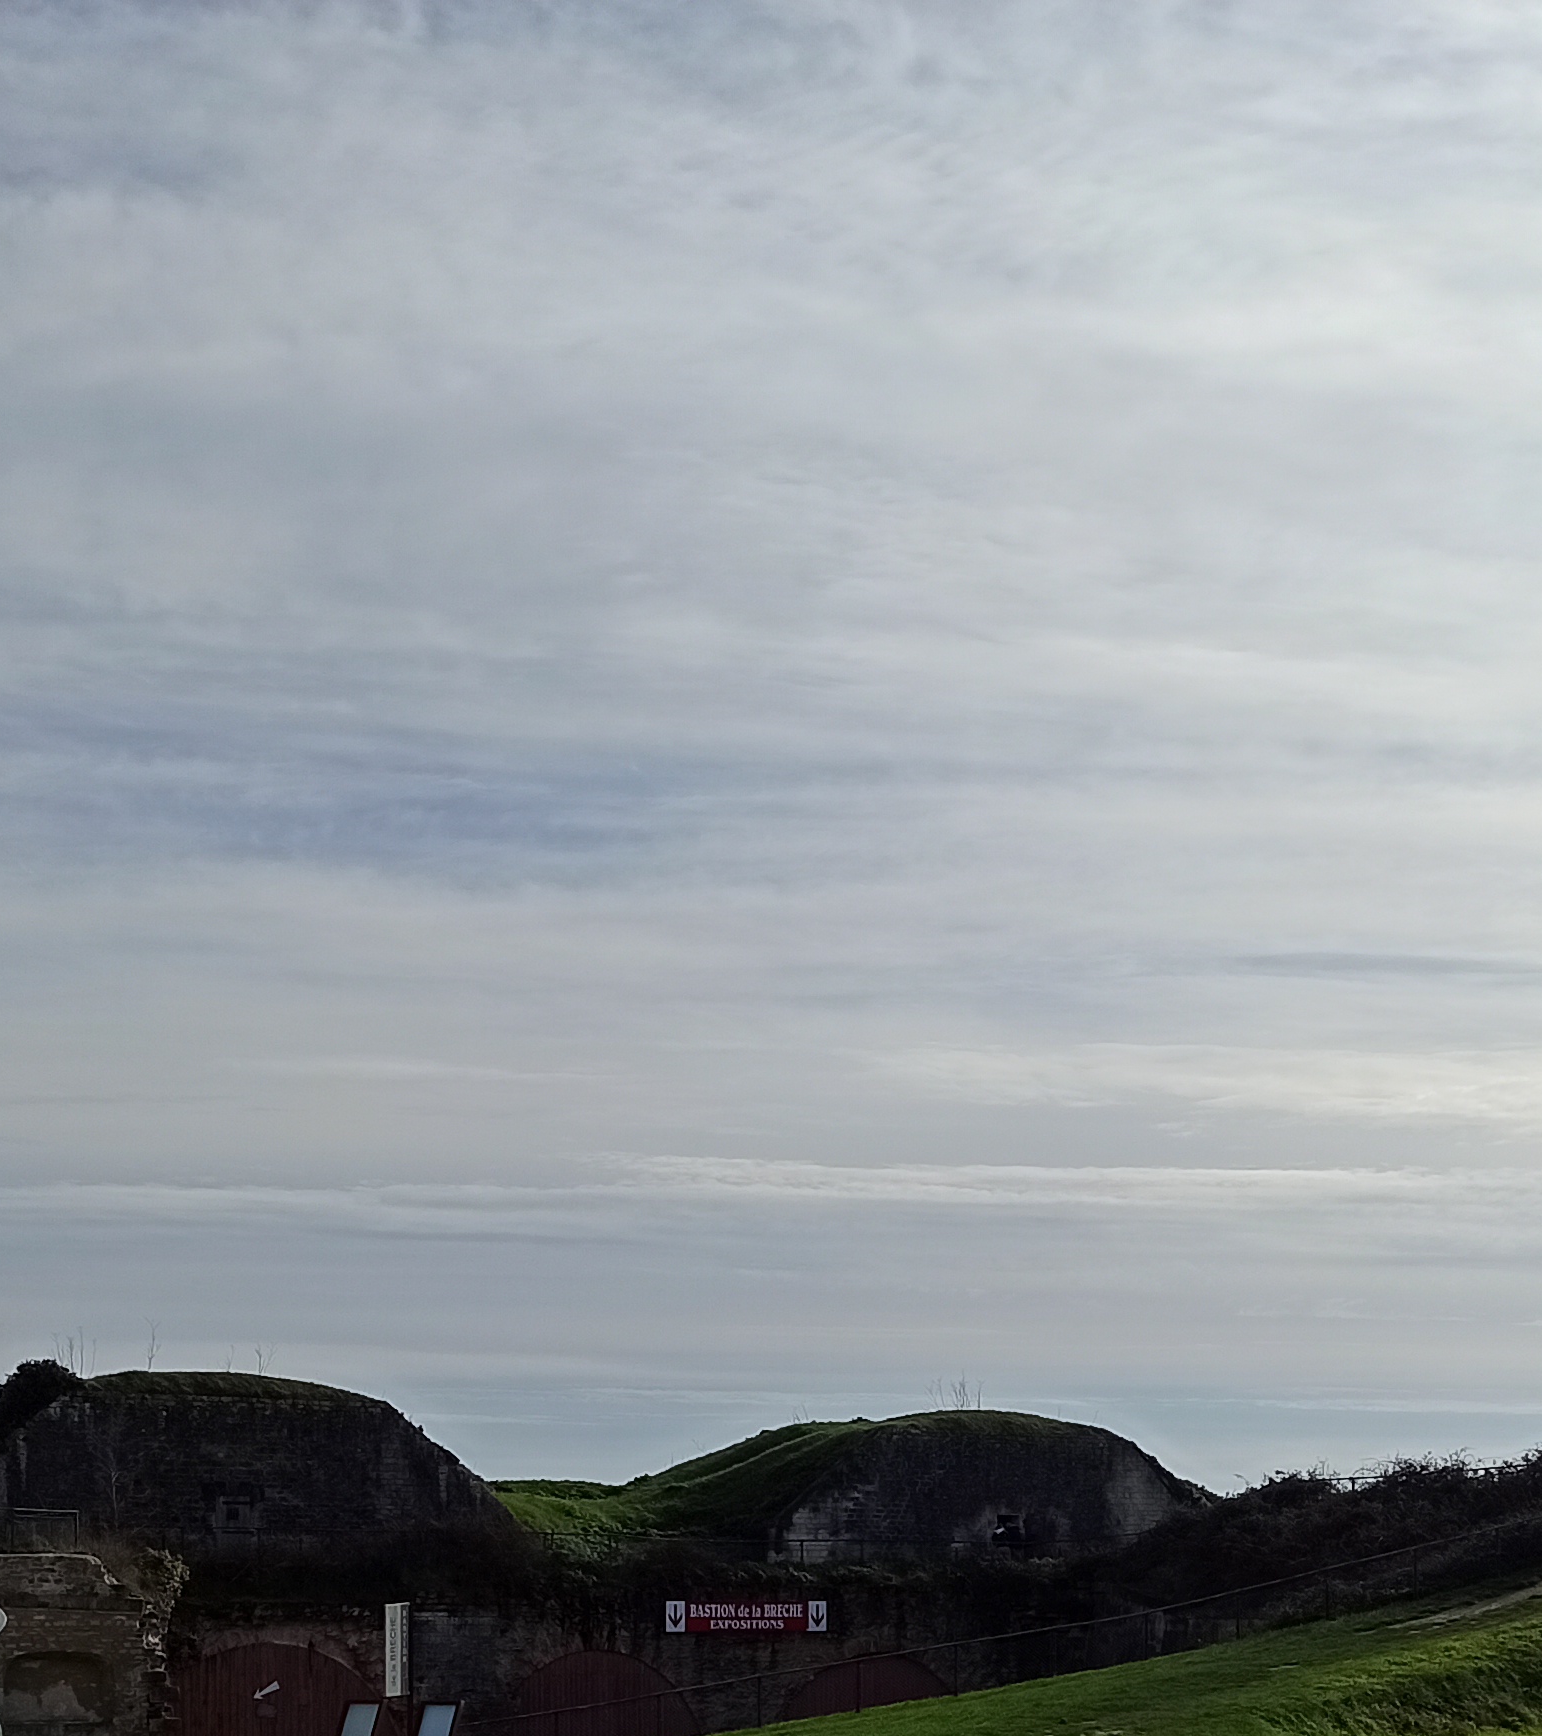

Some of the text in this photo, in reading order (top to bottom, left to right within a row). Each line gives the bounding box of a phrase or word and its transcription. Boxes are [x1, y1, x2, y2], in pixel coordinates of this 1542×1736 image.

[690, 1604, 804, 1618] BASTION de la BRECHE
[710, 1619, 785, 1630] EXPOSITIONS
